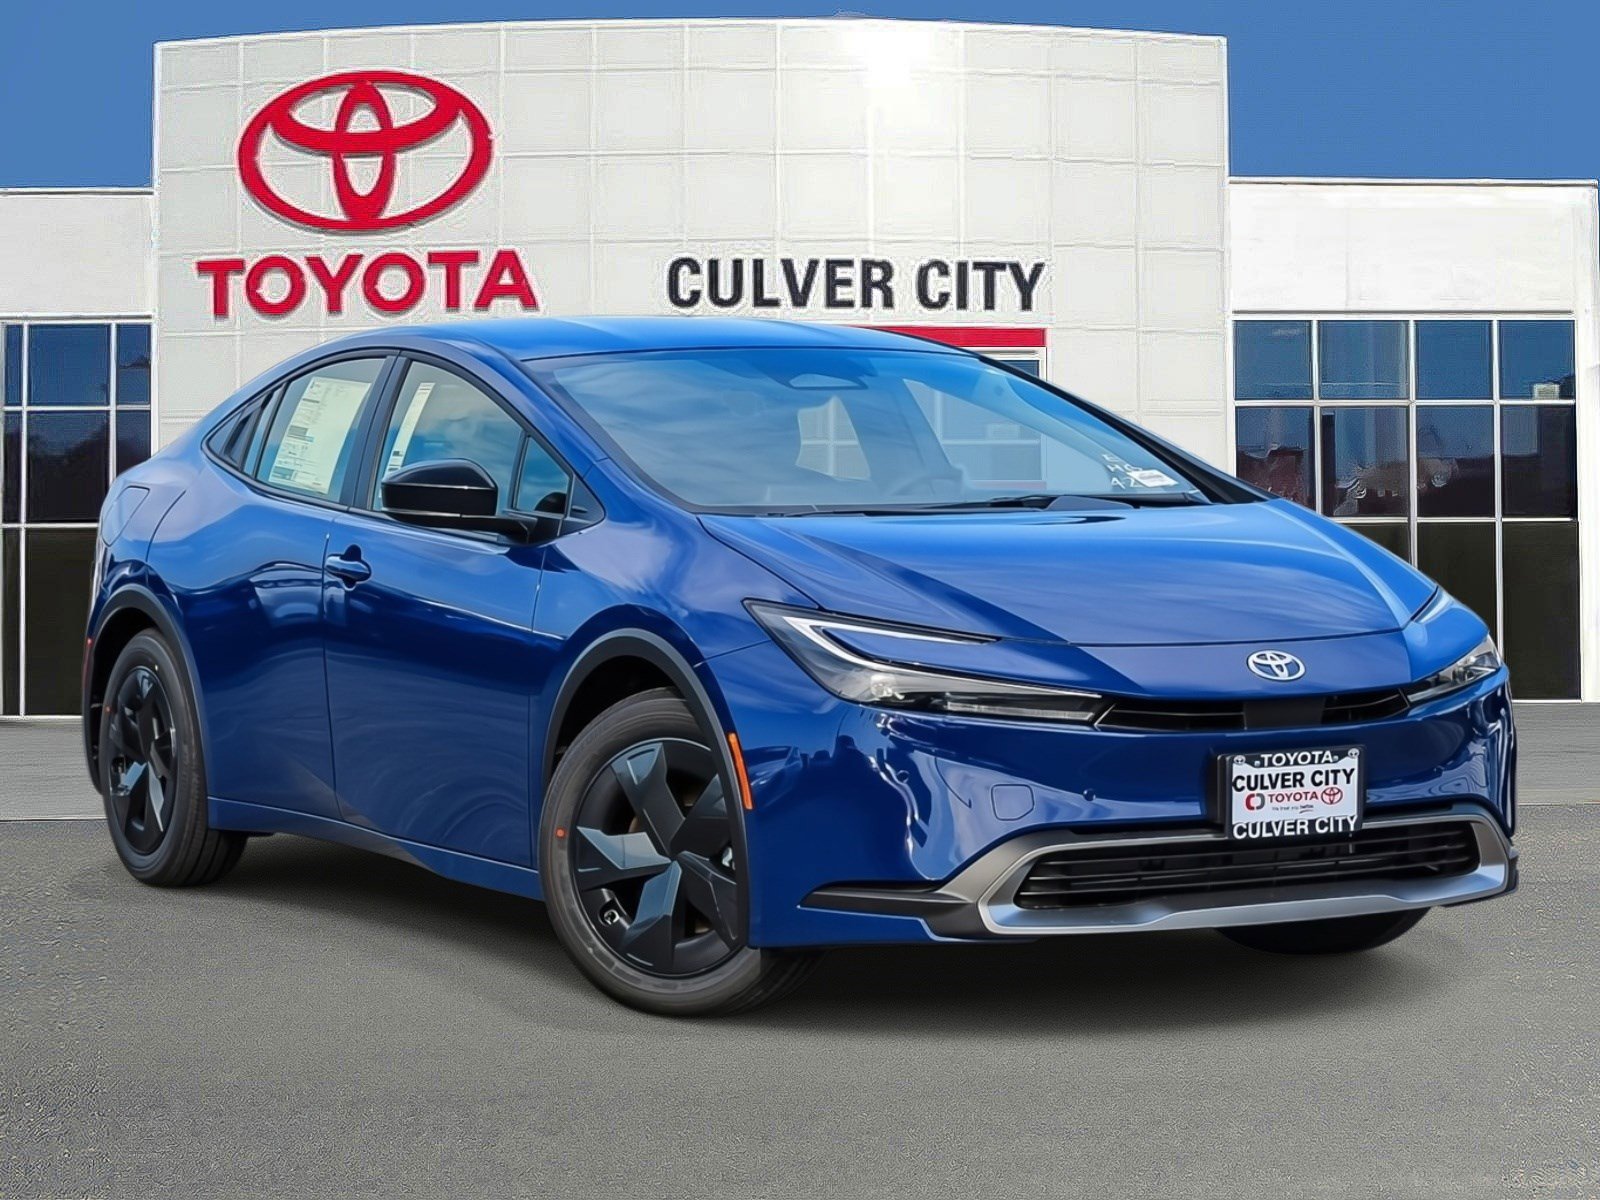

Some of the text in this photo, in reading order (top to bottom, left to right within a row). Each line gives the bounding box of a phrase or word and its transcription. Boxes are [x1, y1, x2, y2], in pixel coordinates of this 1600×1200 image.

[195, 250, 539, 319] TOYOTA
[667, 258, 1046, 311] CULVER CITY
[1260, 750, 1333, 767] TOYOTA
[1232, 768, 1355, 792] CULVER CITY
[1268, 791, 1319, 803] TOYOTA
[1233, 816, 1358, 839] CULVER CITY
